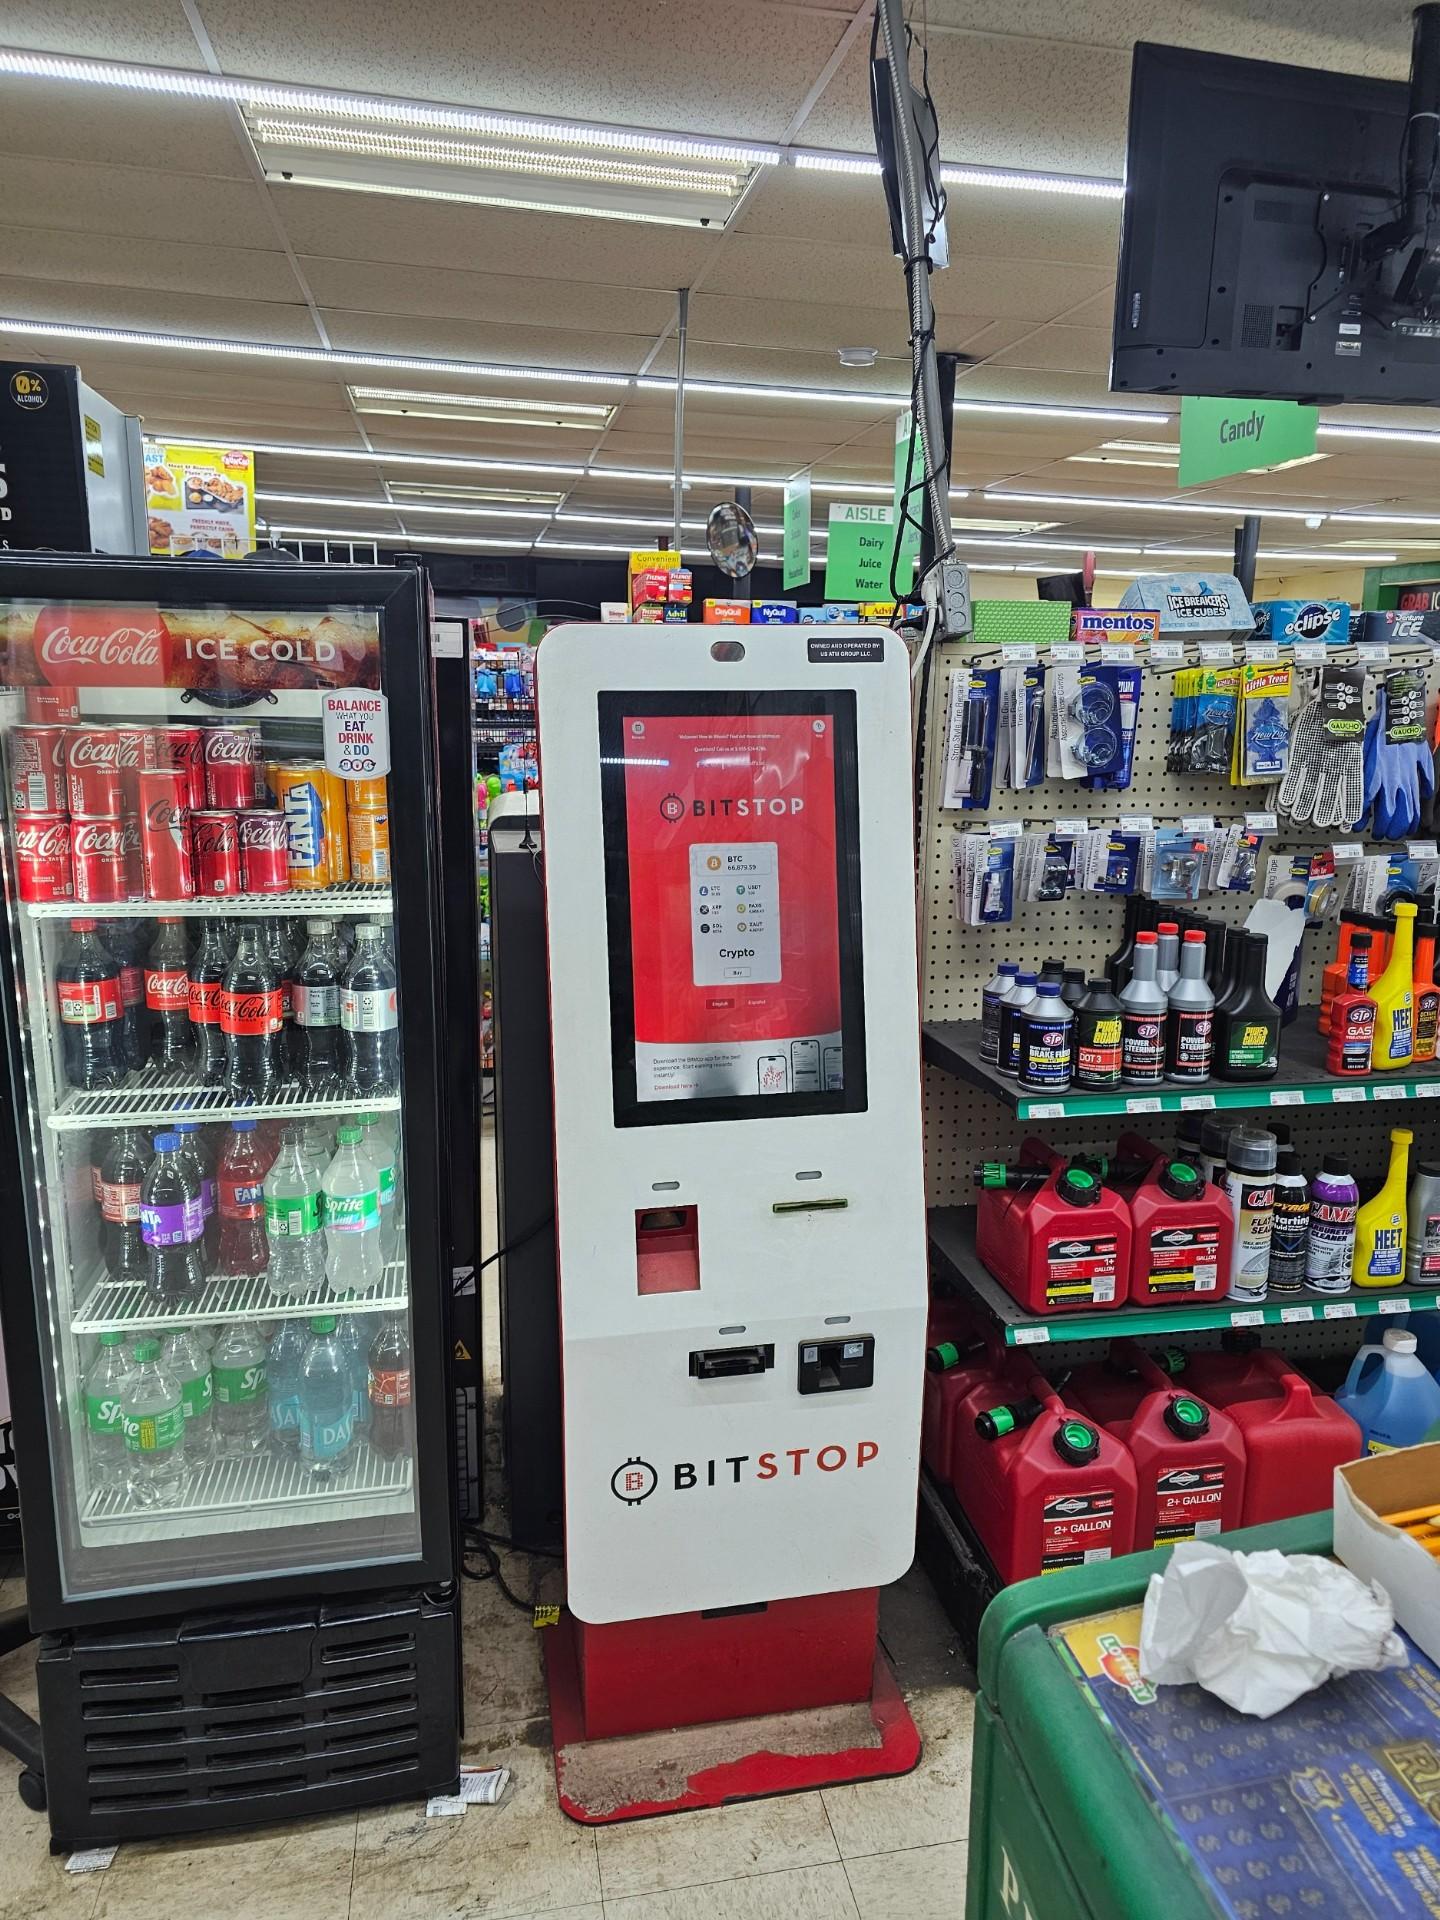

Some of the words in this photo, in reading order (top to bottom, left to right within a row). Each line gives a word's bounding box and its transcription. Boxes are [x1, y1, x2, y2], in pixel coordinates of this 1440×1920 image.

[17, 395, 44, 403] ALCOHOL
[1219, 410, 1265, 444] Candy
[845, 506, 886, 521] AISLE
[859, 536, 884, 550] Dairy
[858, 558, 882, 569] Juice
[855, 579, 883, 589] Water
[1400, 591, 1430, 611] GRAB
[666, 610, 686, 618] Advil
[715, 607, 741, 617] DayQuil
[763, 607, 787, 617] NyQuil
[1176, 608, 1194, 618] ICE
[1193, 607, 1227, 617] CUBES
[1395, 614, 1425, 622] Dentyne
[1082, 615, 1155, 631] mentos
[1284, 608, 1341, 636] eclipse
[1391, 622, 1423, 637] ICE
[41, 626, 164, 665] Coca-Cola
[185, 639, 239, 660] ICE
[250, 639, 336, 661] COLD
[1245, 676, 1266, 693] Little
[1268, 673, 1288, 684] Trees
[327, 699, 382, 711] BALANCE
[336, 712, 357, 720] WHAT
[358, 712, 374, 721] YOU
[1250, 731, 1272, 741] New
[1393, 727, 1420, 736] GAUCHO
[338, 732, 374, 744] DRINK
[343, 745, 352, 755] &
[353, 745, 370, 756] DO
[692, 798, 805, 817] BITSTOP
[284, 783, 316, 868] FANTA
[1268, 859, 1278, 874] Tape
[719, 948, 755, 959] Crypto
[1423, 999, 1436, 1010] STP
[1353, 1010, 1371, 1021] STP
[1392, 1008, 1412, 1031] HEET
[1096, 1020, 1122, 1032] PURE
[1139, 1026, 1158, 1037] STP
[1196, 1023, 1212, 1034] STP
[1347, 1027, 1372, 1035] GAS
[1045, 1033, 1062, 1044] STP
[1124, 1038, 1149, 1046] POWER
[1029, 1049, 1054, 1058] BRAKE
[1124, 1045, 1155, 1053] STEERING
[1080, 1053, 1095, 1062] DOT
[1096, 1055, 1102, 1063] 3
[234, 1185, 263, 1201] FAN
[1248, 1189, 1275, 1207] CA
[325, 1197, 364, 1213] Sprite
[141, 1209, 162, 1225] NTA
[1311, 1231, 1348, 1242] CLEANER
[1375, 1229, 1402, 1249] HEET
[1105, 1258, 1115, 1266] 1+
[1196, 1254, 1217, 1262] GALLON
[323, 1415, 351, 1446] DAS
[673, 1440, 879, 1491] BITSTOP
[1167, 1497, 1181, 1507] 2+
[1182, 1491, 1222, 1506] GALLON
[1054, 1525, 1069, 1535] 2+
[1070, 1519, 1112, 1533] GALLON
[1101, 1636, 1153, 1701] LOTTERY
